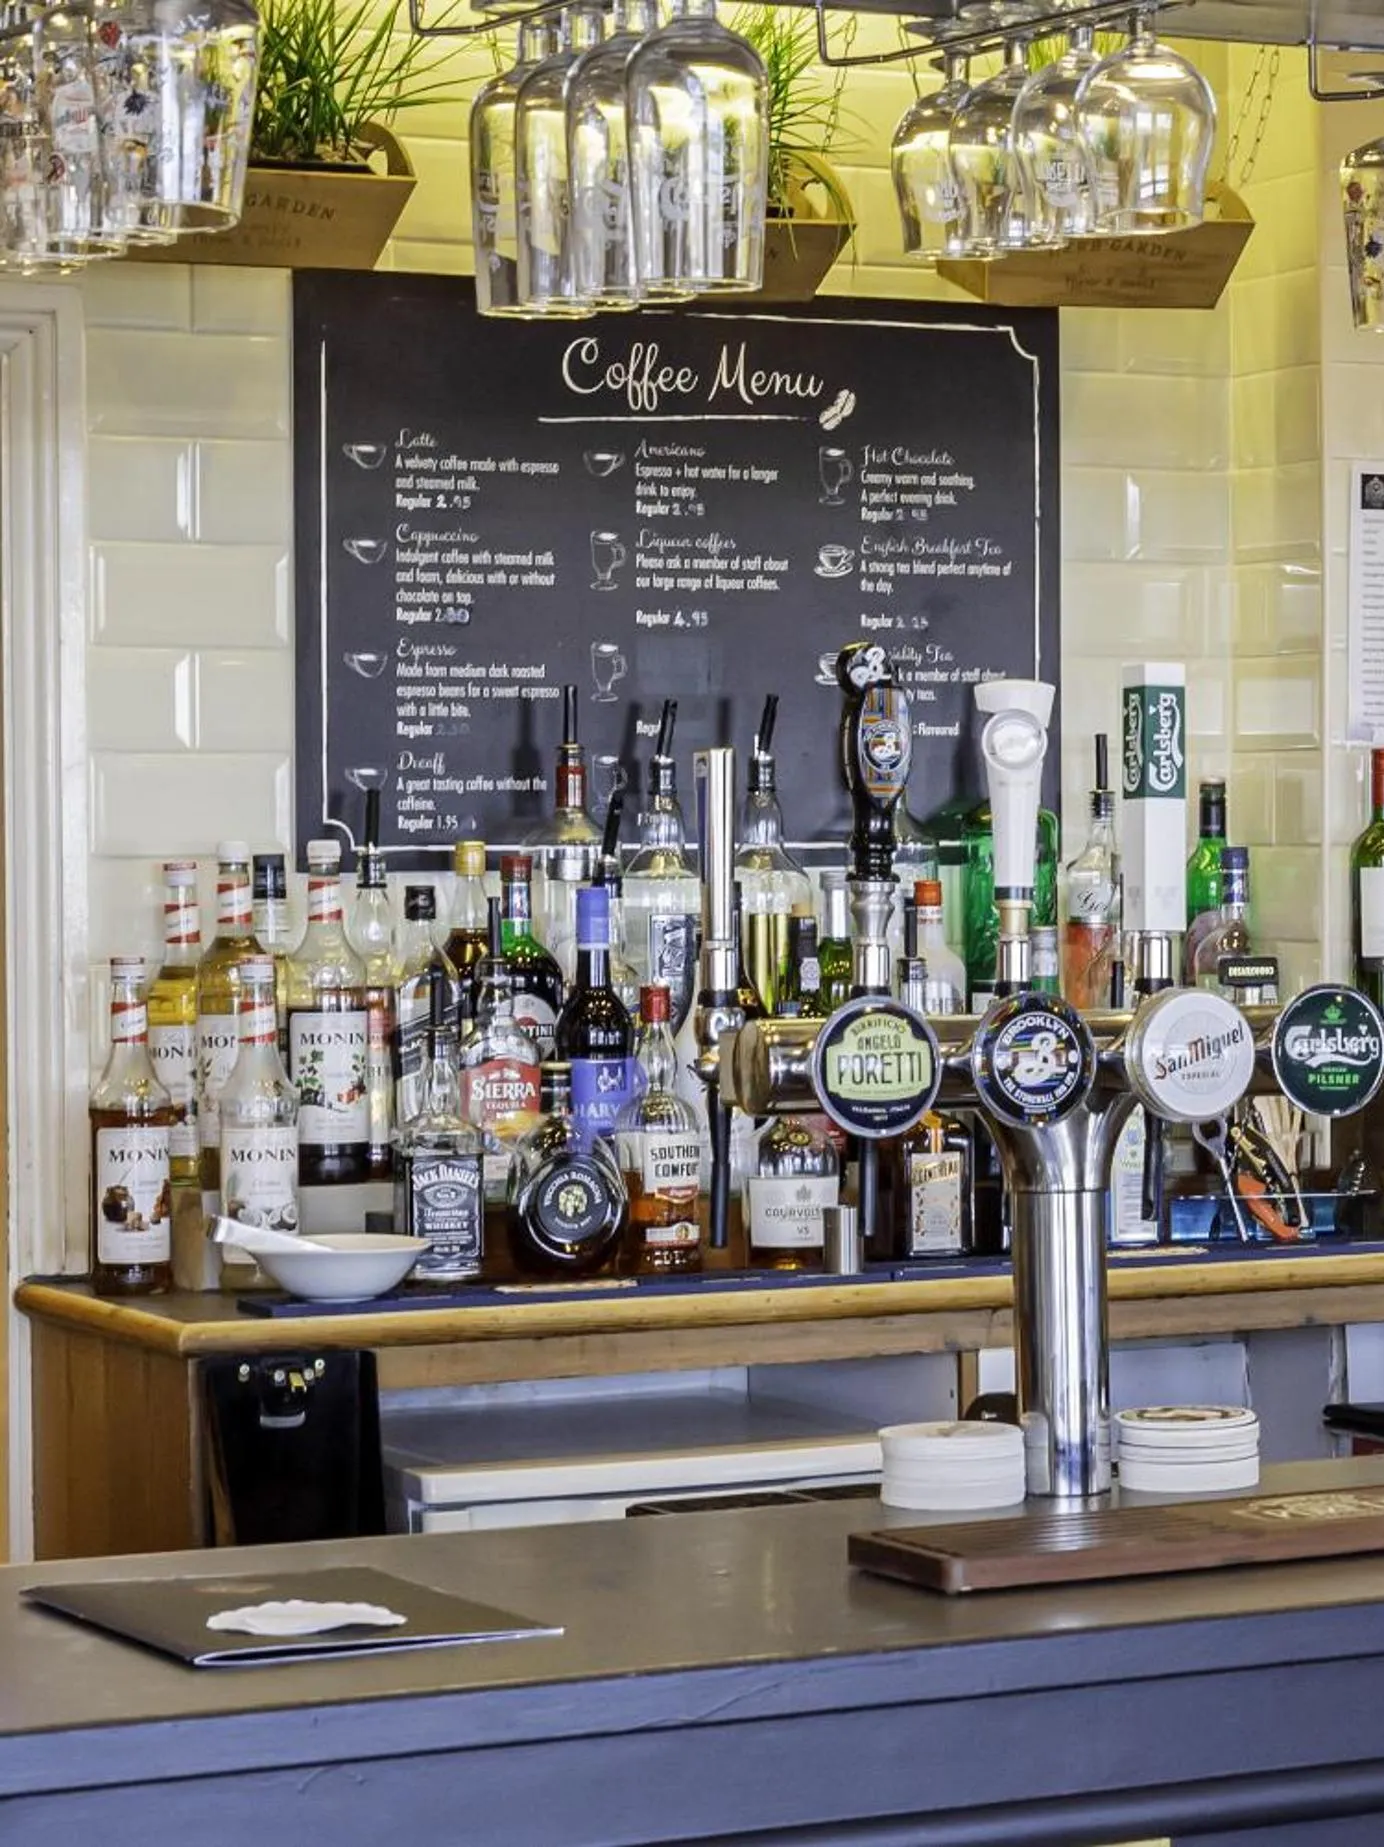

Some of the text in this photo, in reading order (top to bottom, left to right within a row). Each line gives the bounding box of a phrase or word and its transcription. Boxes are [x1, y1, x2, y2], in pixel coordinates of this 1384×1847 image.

[562, 337, 823, 411] Coffee Menu
[394, 428, 438, 449] Latte
[634, 438, 707, 459] Americano
[861, 444, 956, 467] Hot Chocolate
[395, 454, 403, 469] A
[439, 455, 468, 471] coffee
[470, 457, 497, 472] made
[499, 457, 519, 472] with
[520, 461, 560, 475] espresso
[635, 463, 673, 479] Espresso
[684, 463, 700, 478] hot
[702, 467, 726, 480] water
[728, 464, 741, 480] for
[751, 465, 779, 484] longer
[395, 474, 414, 490] and
[415, 475, 455, 490] steamed
[861, 470, 892, 487] Creamy
[894, 474, 919, 486] warm
[920, 471, 937, 486] and
[635, 481, 657, 497] drink
[660, 484, 669, 497] to
[861, 489, 868, 503] A
[869, 489, 898, 506] perfect
[395, 493, 432, 511] Regular
[635, 500, 670, 517] Regular
[861, 507, 894, 523] Regular
[396, 523, 480, 549] Cappuccino
[635, 528, 693, 554] Liqueur
[396, 548, 439, 566] Indulgent
[441, 548, 470, 564] coffee
[472, 550, 492, 565] with
[494, 551, 533, 566] steamed
[860, 535, 1002, 561] English Breakfast Tea
[636, 552, 665, 569] Please
[666, 555, 682, 569] ask
[692, 556, 728, 570] member
[730, 555, 740, 570] of
[742, 555, 762, 570] staff
[763, 556, 789, 571] about
[860, 559, 1012, 579] A strong tea blend perfect anytime of
[395, 568, 414, 583] and
[446, 568, 485, 584] delicious
[487, 570, 507, 585] with
[509, 573, 520, 585] or
[521, 571, 556, 586] without
[636, 576, 651, 588] our
[653, 572, 674, 591] large
[677, 577, 701, 592] range
[704, 573, 714, 589] of
[715, 574, 745, 592] liqueur
[860, 578, 874, 593] the
[396, 588, 440, 604] chocolate
[441, 591, 454, 604] on
[396, 607, 432, 625] Regular
[635, 609, 670, 628] Regular
[860, 613, 894, 630] Regular
[925, 644, 954, 662] Tea
[396, 662, 546, 678] Made from medium dark roasted
[915, 669, 949, 682] member
[951, 669, 961, 682] of
[962, 669, 981, 682] staff
[396, 684, 436, 699] espresso
[438, 682, 466, 698] beans
[468, 682, 480, 697] for
[521, 686, 560, 701] espresso
[396, 702, 417, 717] with
[419, 705, 427, 717] a
[428, 702, 449, 717] little
[396, 721, 433, 739] Regular
[635, 718, 661, 737] Regul
[918, 722, 960, 737] Flavoured
[1123, 693, 1143, 793] Carlsberg
[1149, 693, 1183, 792] Carlsberg
[397, 751, 446, 776] Decaff
[396, 776, 547, 794] A great tasting coffee without the
[397, 815, 434, 832] Regular
[300, 1032, 365, 1046] MONIN
[1001, 1015, 1070, 1045] BROOKLYN
[857, 1034, 902, 1051] ANGELO
[1188, 1020, 1245, 1061] Miguel
[1284, 1024, 1380, 1068] Carlsberg
[837, 1051, 923, 1086] PORETTI
[471, 1075, 536, 1101] SIERRA
[1307, 1073, 1360, 1085] PILSNER
[231, 1149, 296, 1163] MONIN
